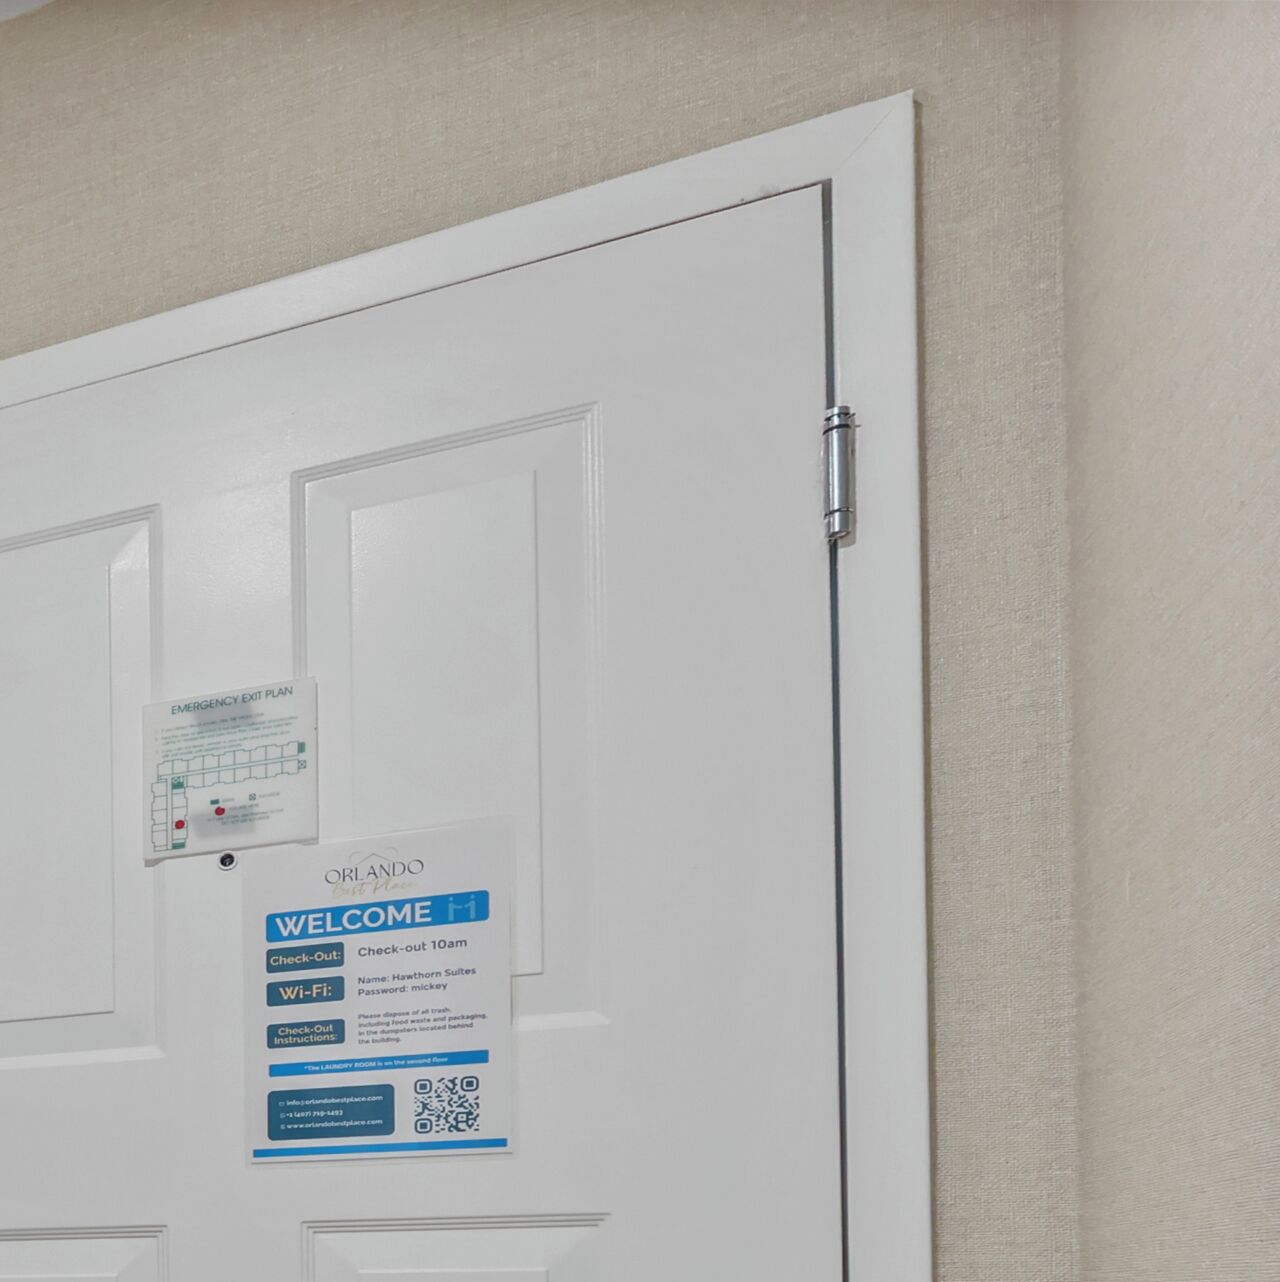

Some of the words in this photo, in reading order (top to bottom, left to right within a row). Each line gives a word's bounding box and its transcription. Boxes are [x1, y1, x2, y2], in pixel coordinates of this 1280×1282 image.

[171, 695, 239, 715] EMERGENCY
[241, 690, 263, 703] EXIT
[265, 686, 293, 699] PLAN
[324, 859, 424, 885] ORLANDO
[275, 901, 432, 937] WELCOME
[358, 942, 428, 957] Check-out
[431, 938, 468, 950] 10am
[270, 951, 341, 966] Check-Out:
[358, 976, 390, 985] Name:
[392, 971, 442, 982] Hawthorn
[444, 966, 477, 977] Suites
[279, 984, 332, 1000] Wi-Fi:
[358, 985, 409, 997] Password:
[411, 982, 448, 993] mickey
[278, 1024, 334, 1036] Check-Out
